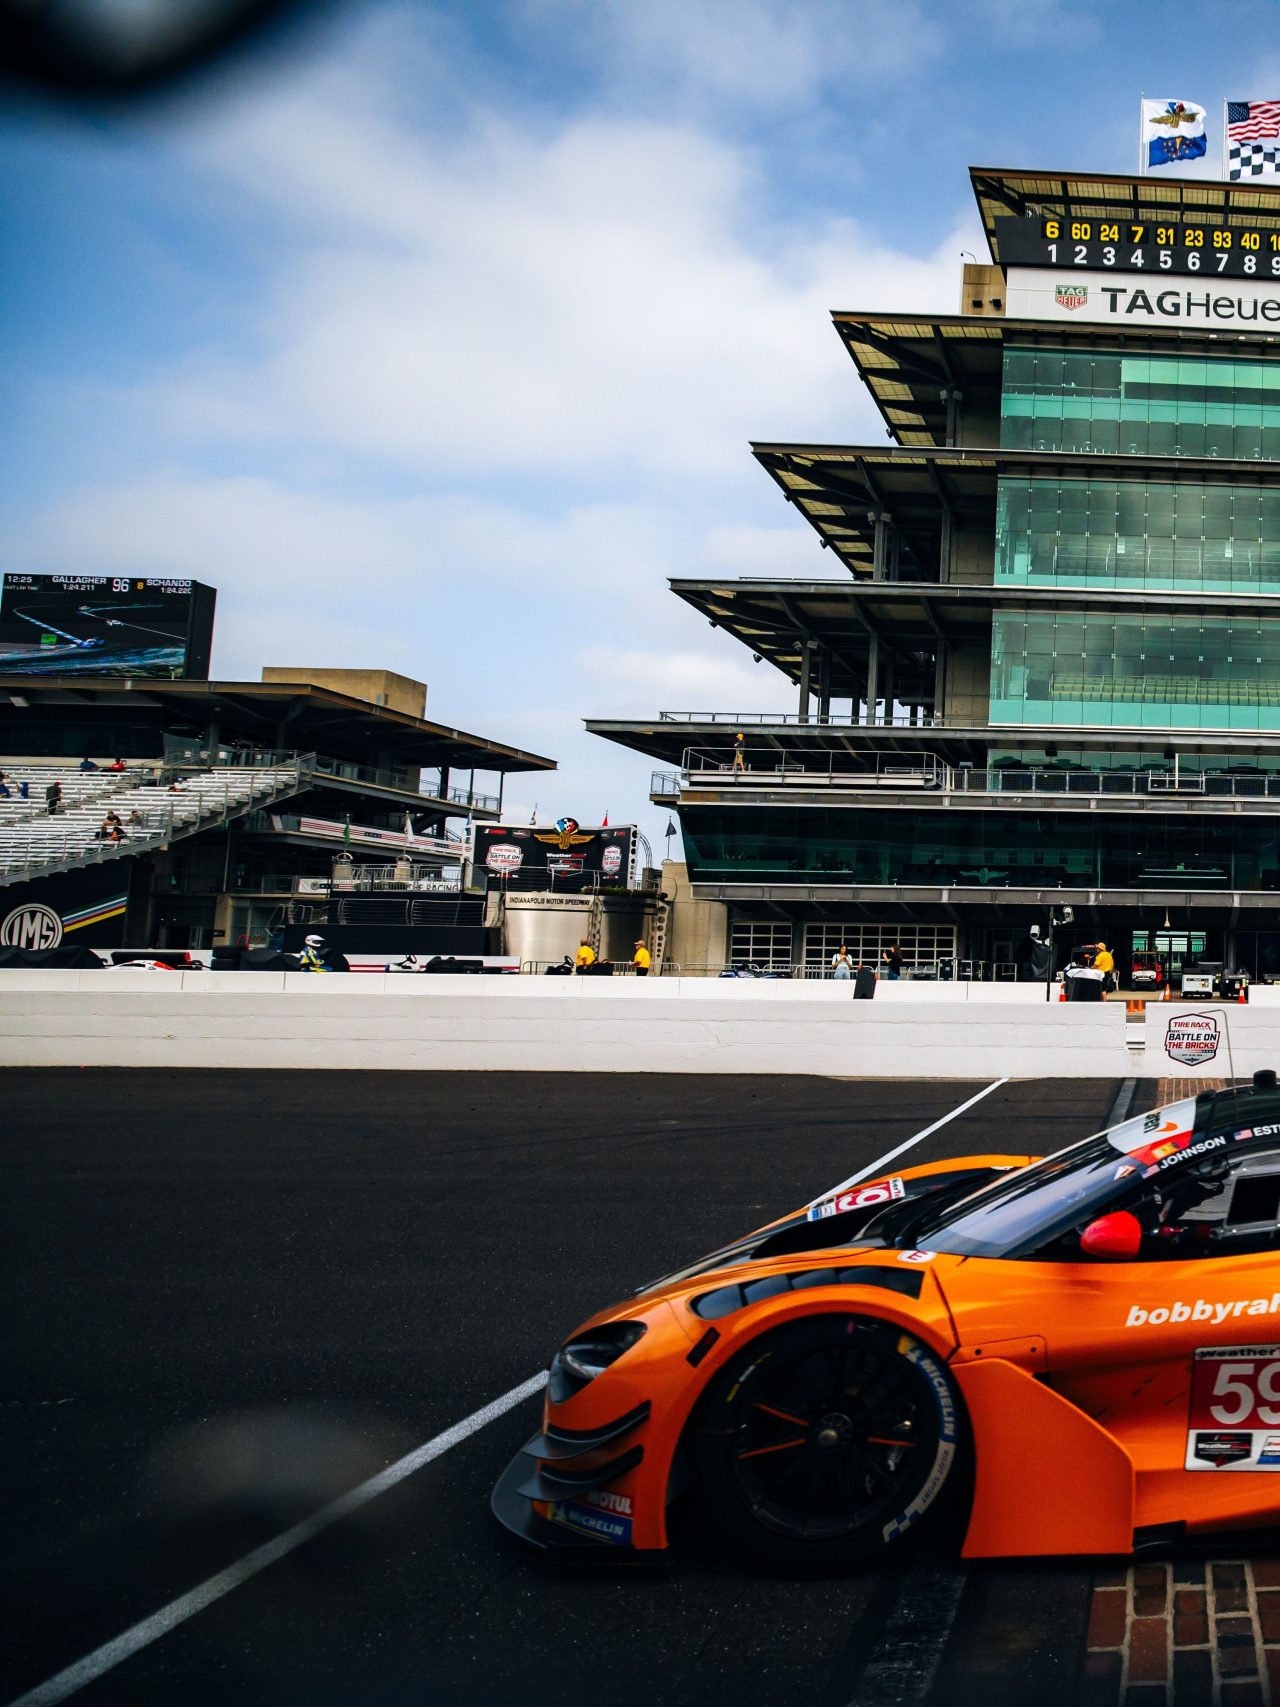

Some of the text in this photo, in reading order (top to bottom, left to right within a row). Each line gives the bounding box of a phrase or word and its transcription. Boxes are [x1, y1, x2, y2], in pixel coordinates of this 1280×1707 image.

[1045, 222, 1059, 238] 6
[1071, 223, 1091, 240] 60
[1100, 225, 1120, 242] 24
[1131, 226, 1144, 243] 7
[1156, 228, 1175, 245] 31
[1184, 229, 1204, 247] 23
[1213, 231, 1232, 248] 93
[1240, 233, 1260, 250] 40
[1047, 244, 1057, 262] 1
[1074, 245, 1087, 264] 2
[1102, 247, 1115, 265] 3
[1130, 248, 1144, 267] 4
[1159, 251, 1172, 269] 5
[1187, 252, 1200, 270] 6
[1216, 254, 1228, 272] 7
[1243, 255, 1256, 273] 8
[1058, 286, 1085, 295] TAG
[1057, 295, 1087, 305] HEUER
[8, 575, 33, 583] 12:25
[52, 576, 107, 585] GALLAGHER
[112, 578, 130, 593] 96
[137, 582, 144, 590] 8
[12, 912, 54, 949] IMS
[1190, 1021, 1212, 1031] RACK
[1168, 1033, 1217, 1041] BATTLE ON
[1168, 1041, 1216, 1049] THE BRICKS
[1160, 1136, 1226, 1170] JOHNSON
[920, 1358, 955, 1436] MICHELIN
[586, 1490, 633, 1514] MOTUL
[568, 1509, 624, 1536] MICHELIN
